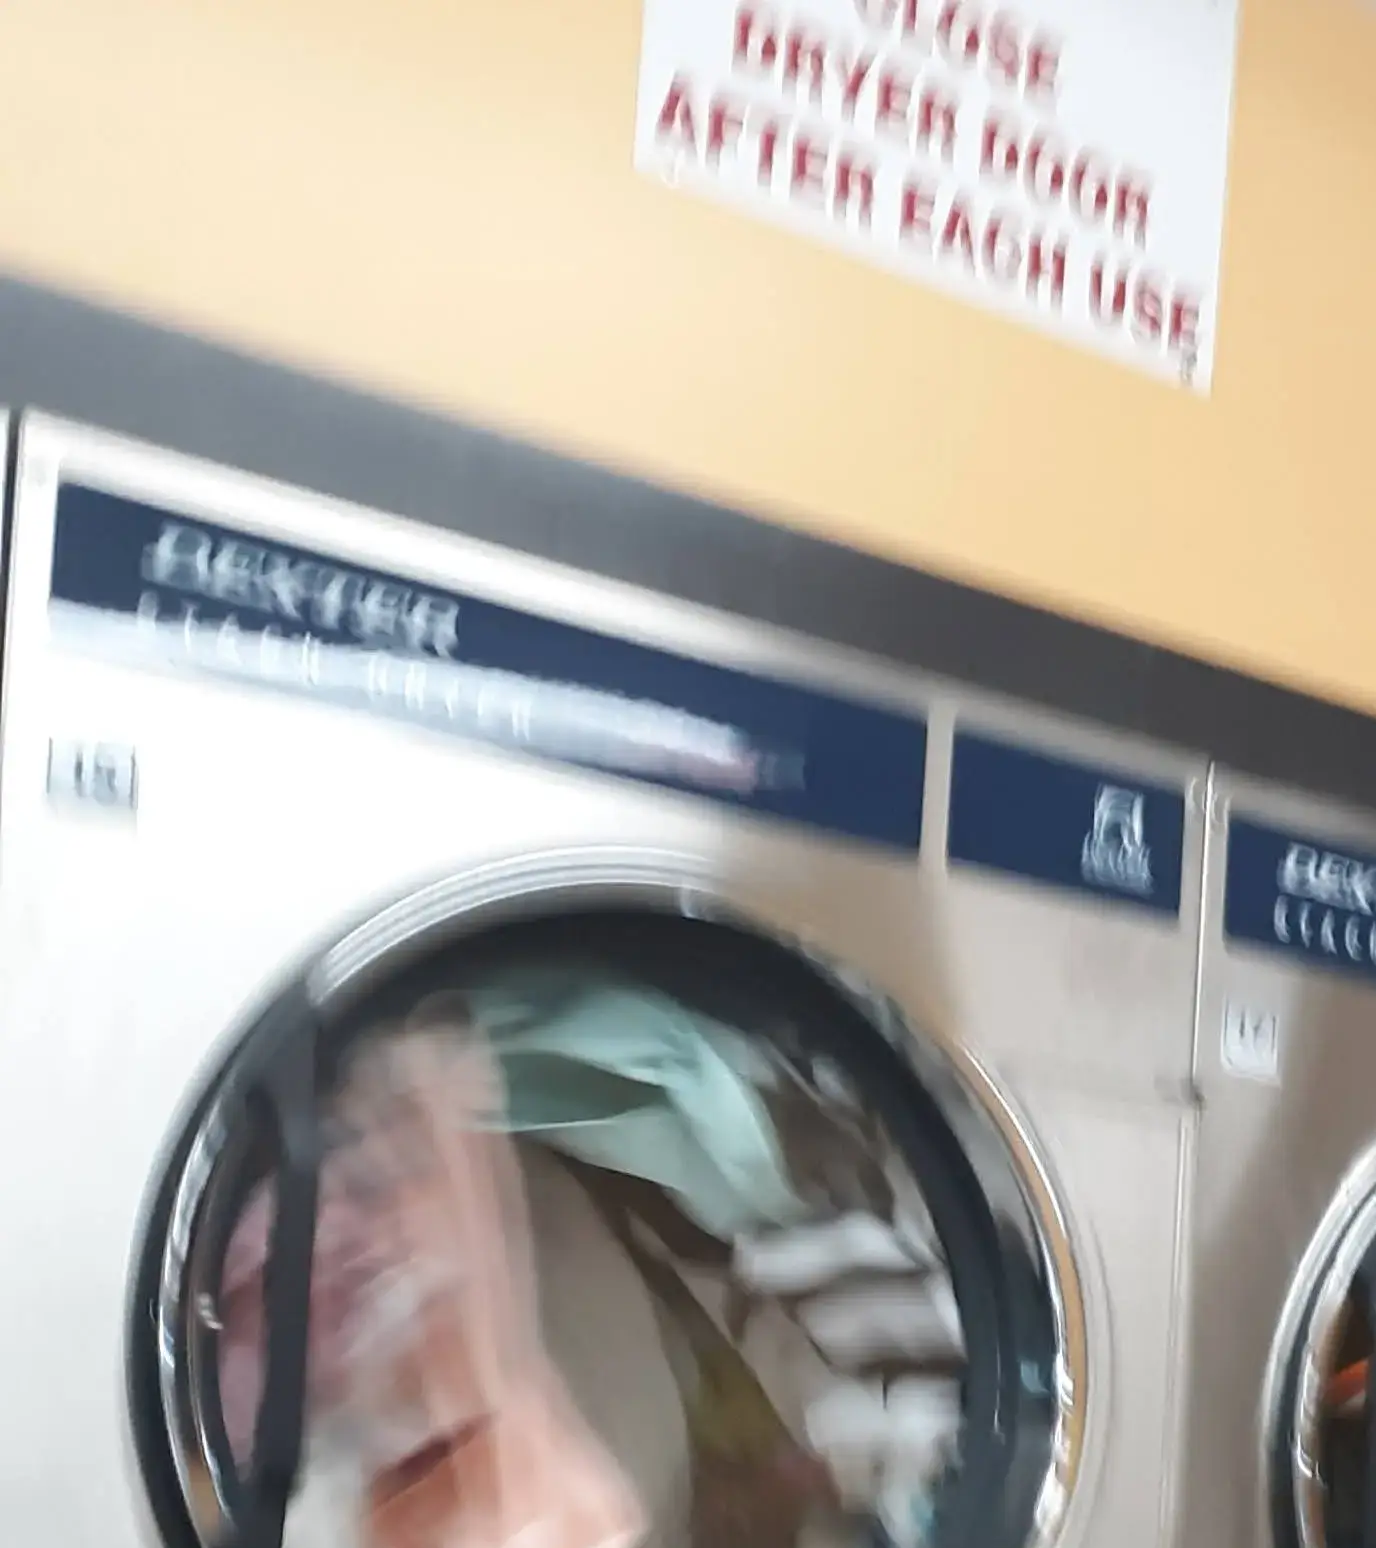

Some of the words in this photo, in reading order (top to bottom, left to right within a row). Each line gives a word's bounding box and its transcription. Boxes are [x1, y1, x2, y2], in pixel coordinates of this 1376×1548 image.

[655, 68, 876, 230] AFTER
[899, 170, 1068, 310] EACH
[1088, 252, 1202, 352] USE
[732, 4, 958, 158] DRYER
[980, 108, 1153, 248] DOOR
